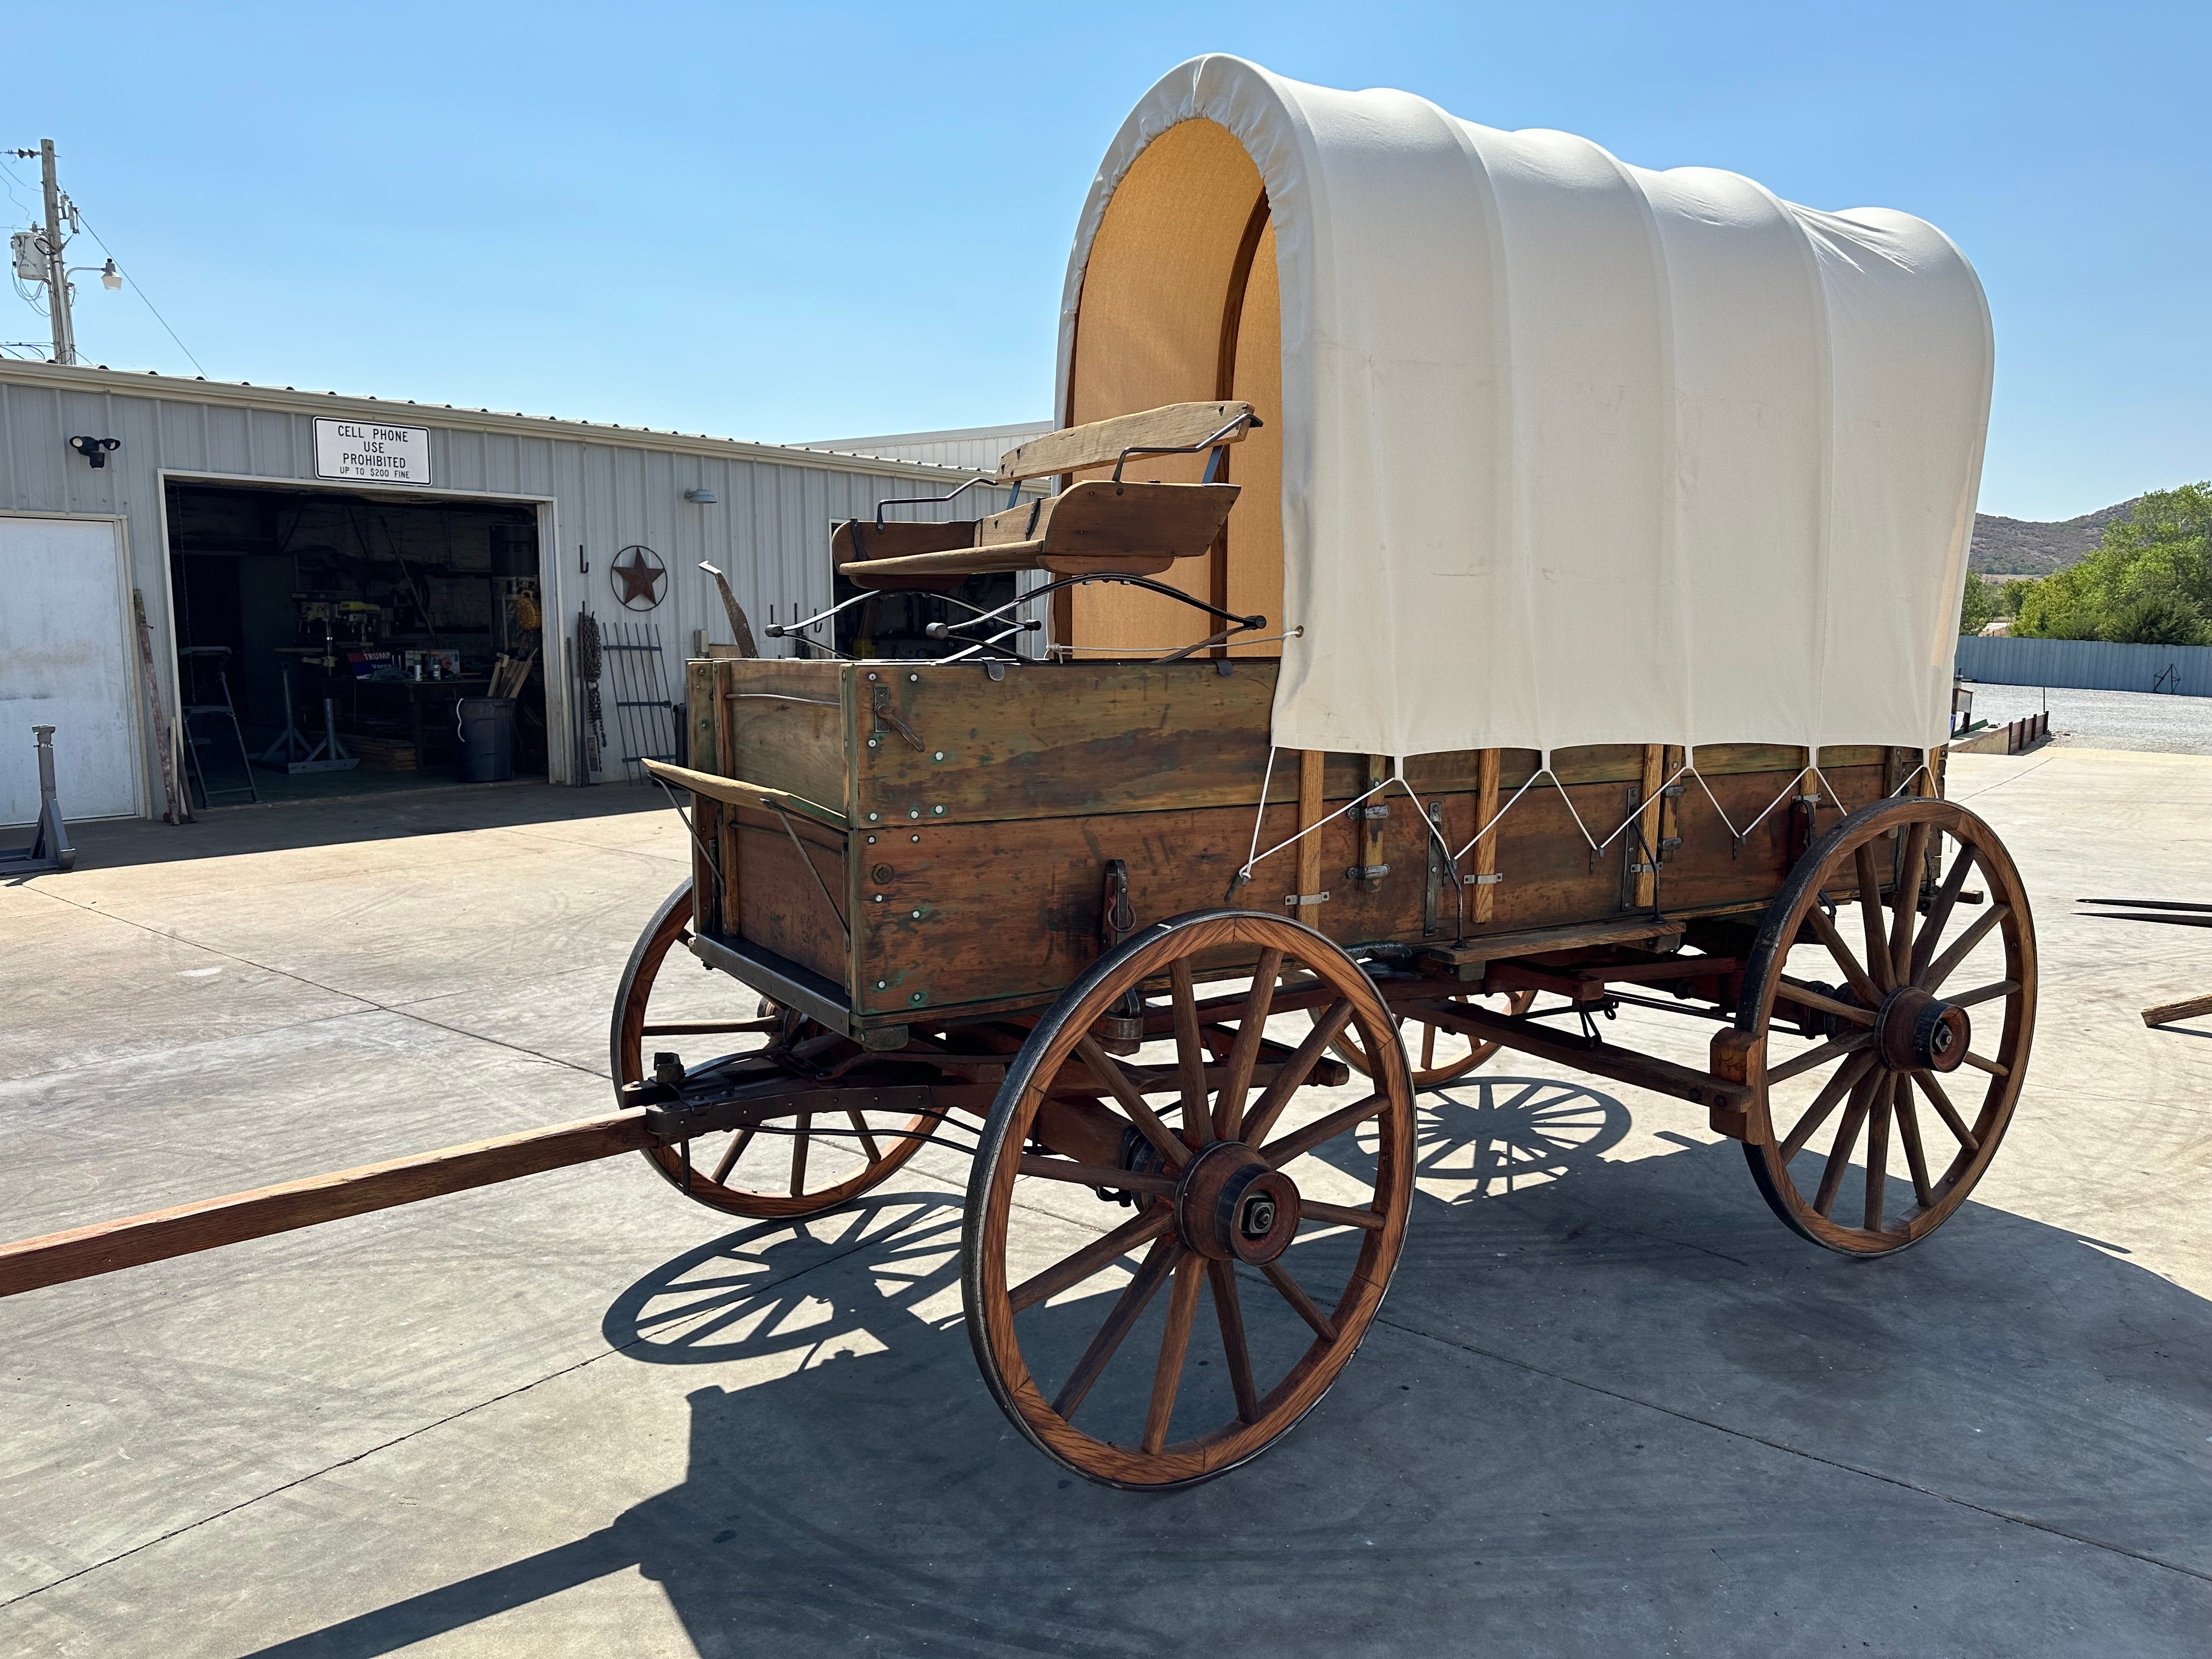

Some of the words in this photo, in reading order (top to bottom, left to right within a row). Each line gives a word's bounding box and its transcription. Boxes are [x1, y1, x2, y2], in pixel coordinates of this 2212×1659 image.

[338, 425, 364, 438] CELL
[373, 428, 408, 442] PHONE
[364, 441, 385, 453] USE
[343, 453, 405, 468] PROHIBITED
[356, 467, 365, 476] TO
[370, 468, 389, 477] $200
[394, 470, 410, 478] FINE
[363, 652, 391, 661] TRUMP
